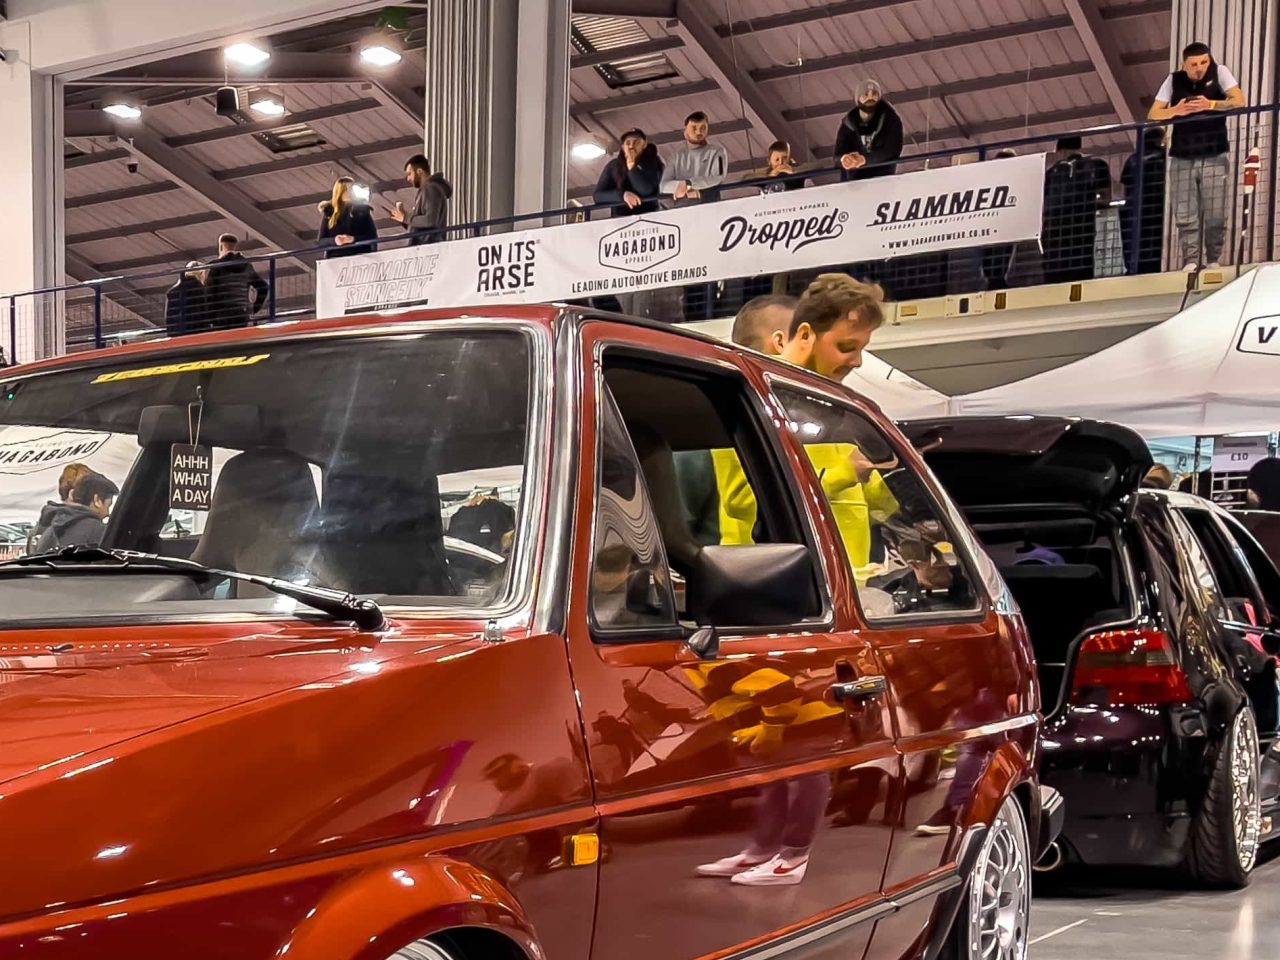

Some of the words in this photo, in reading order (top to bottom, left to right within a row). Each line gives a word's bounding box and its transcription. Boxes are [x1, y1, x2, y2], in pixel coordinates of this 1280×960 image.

[477, 243, 503, 267] ON
[507, 240, 536, 263] ITS
[604, 233, 676, 258] VAGABOND
[336, 254, 440, 288] AUTOMOTIVE
[476, 262, 535, 292] ARSE
[572, 279, 609, 293] LEADING
[611, 270, 669, 288] AUTOMOTIVE
[671, 265, 708, 281] BRANDS
[173, 454, 209, 470] AHHH
[173, 471, 210, 487] WHAT
[172, 488, 182, 502] A
[184, 488, 210, 504] DAY
